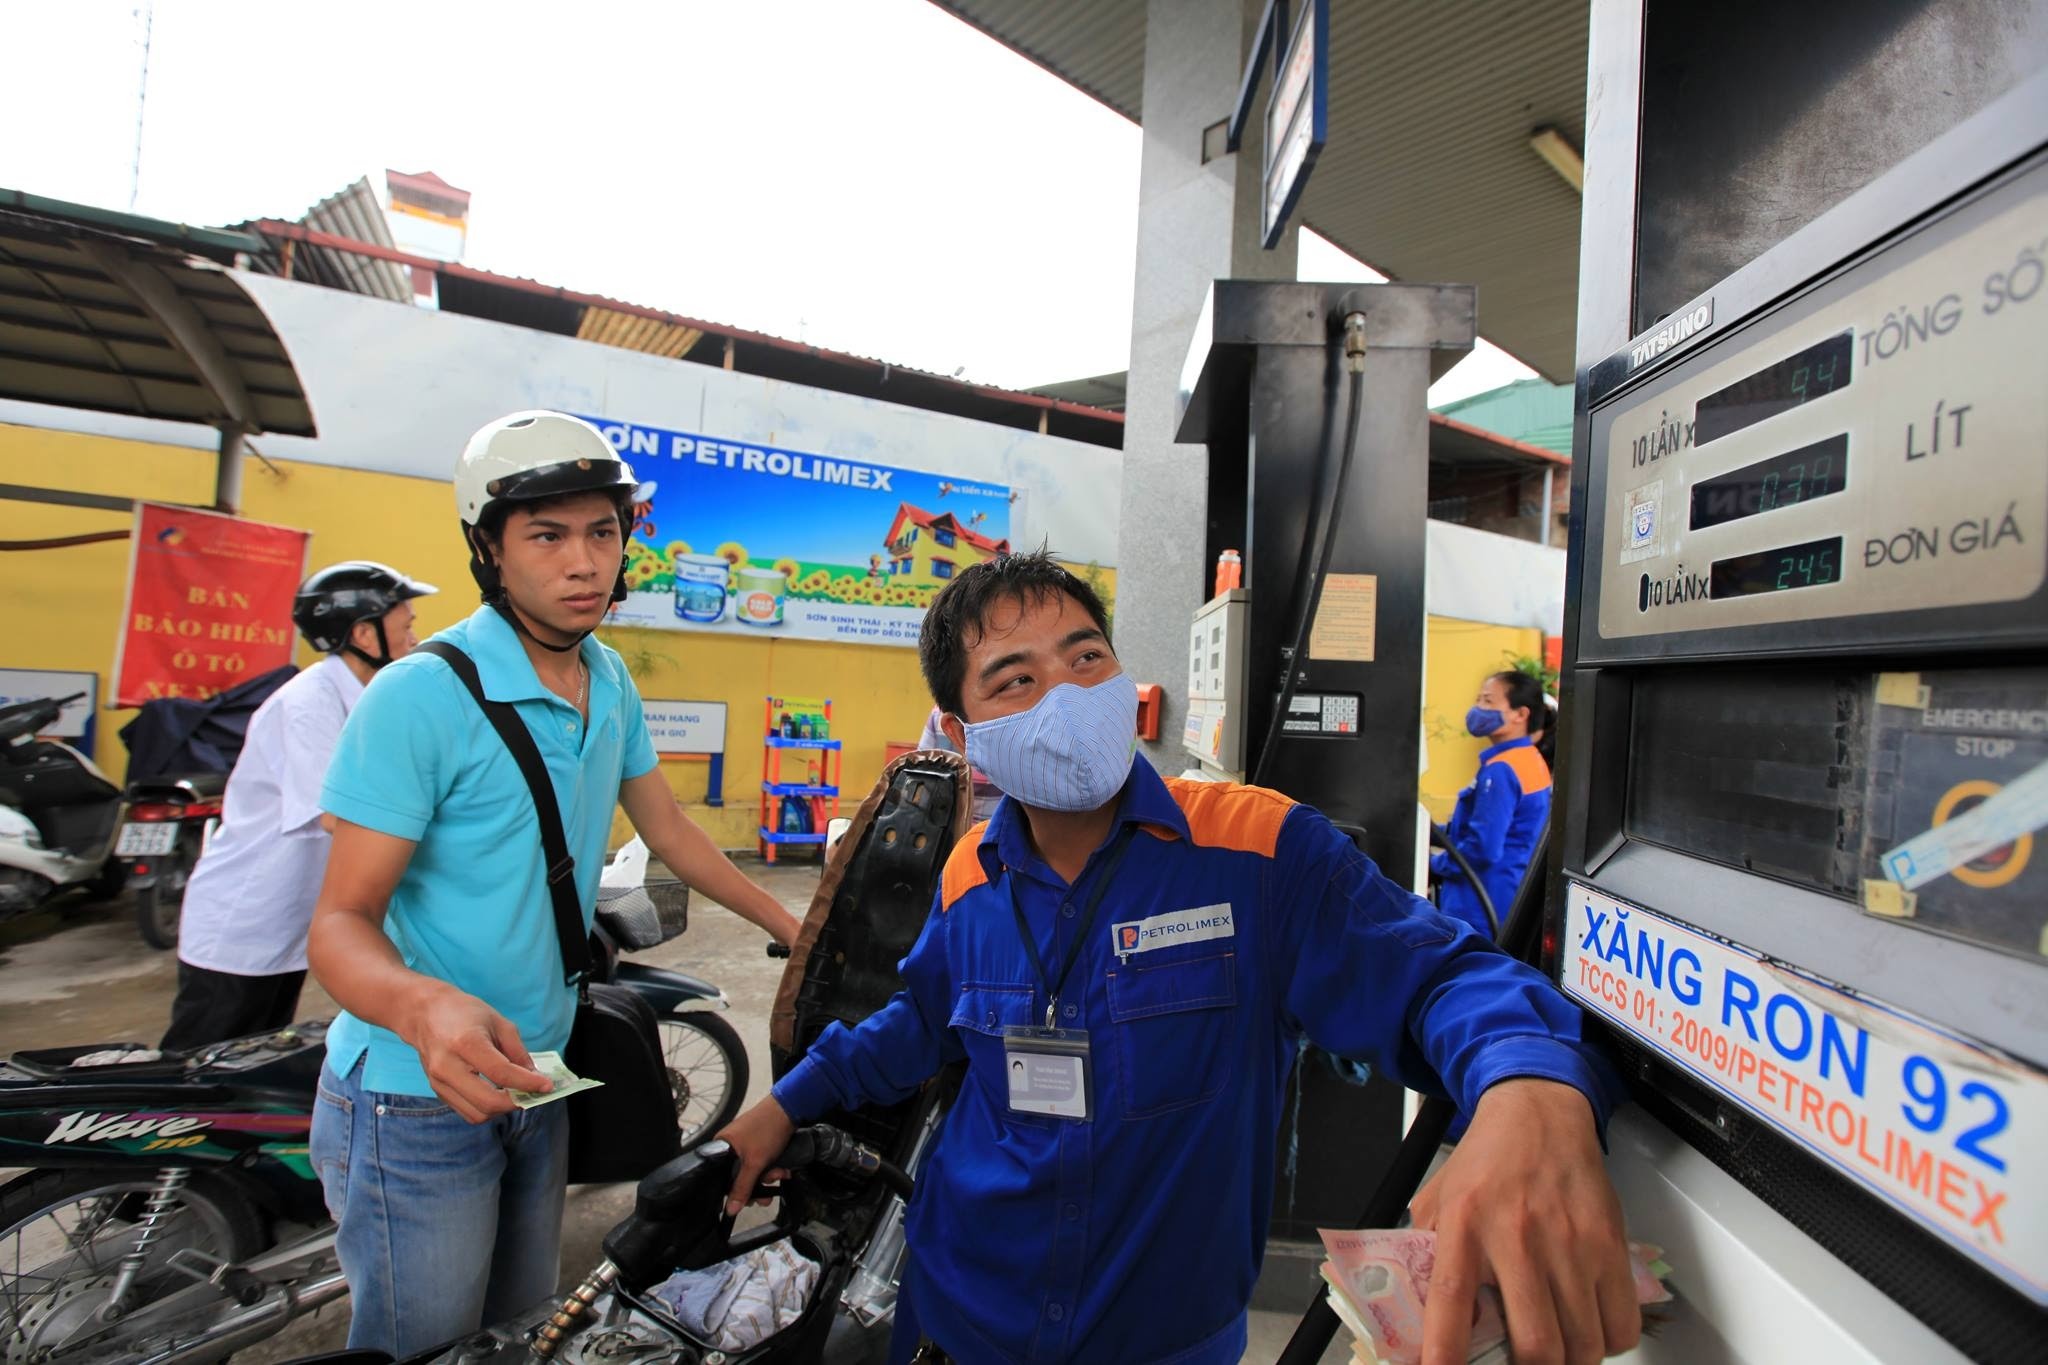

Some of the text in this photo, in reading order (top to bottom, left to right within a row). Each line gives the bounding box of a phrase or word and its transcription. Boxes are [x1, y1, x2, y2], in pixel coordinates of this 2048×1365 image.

[1631, 305, 1708, 368] TATSUNO
[1859, 293, 1964, 367] TỔNG
[601, 423, 893, 492] ƠN PETROLIMEX
[1905, 399, 1973, 462] LÍT
[1864, 500, 2024, 568] ĐƠN GIÁ
[1776, 550, 1832, 590] 245
[1922, 708, 2048, 733] EMERGENC
[1955, 736, 2015, 759] STOP
[1140, 915, 1231, 941] PETROLIMEX
[1581, 904, 2010, 1174] XĂNG RON 92
[43, 1110, 213, 1145] Wave
[1578, 956, 1627, 1012] TCCS
[1671, 1010, 2010, 1245] 2009/PETROLIMEX
